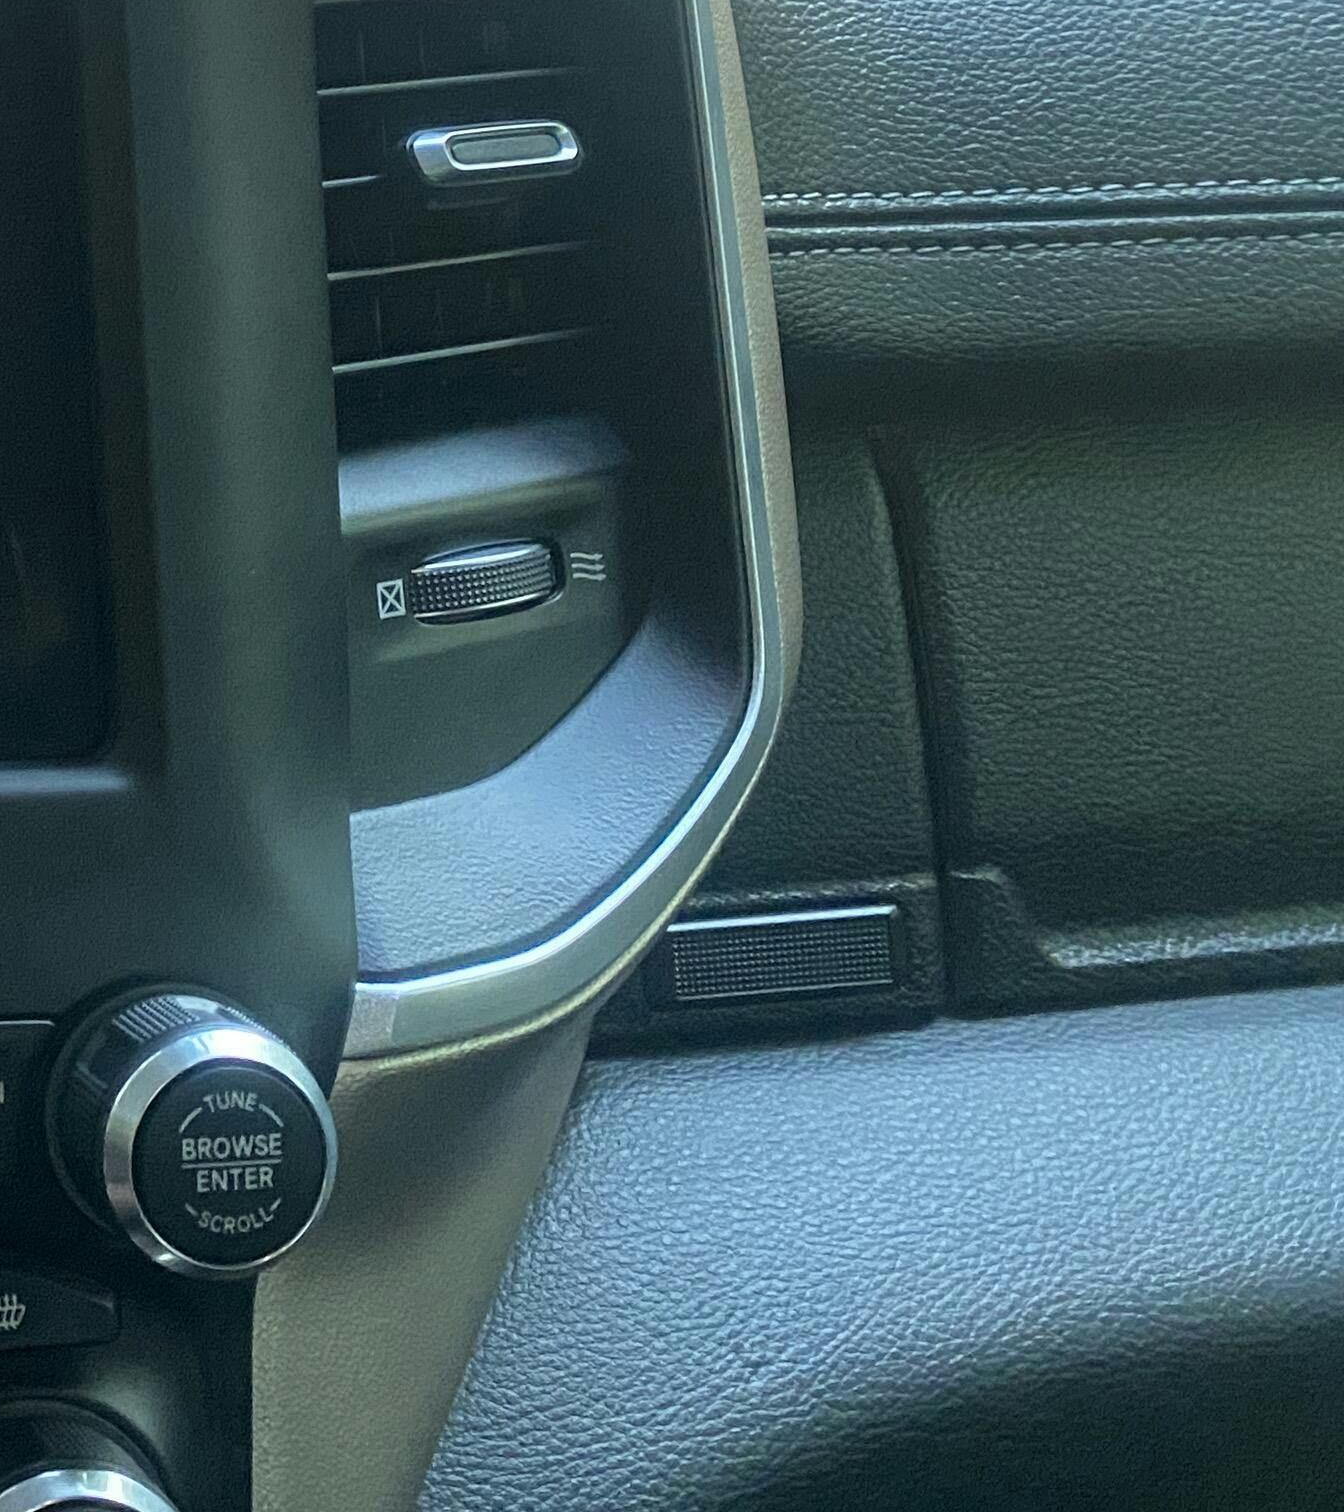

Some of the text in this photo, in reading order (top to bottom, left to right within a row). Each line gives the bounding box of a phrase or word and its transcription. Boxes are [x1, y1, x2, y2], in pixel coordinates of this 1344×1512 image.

[202, 1092, 259, 1114] TUNE
[181, 1133, 283, 1161] BROWSE
[196, 1166, 275, 1193] ENTER
[197, 1209, 275, 1235] SCROLL
